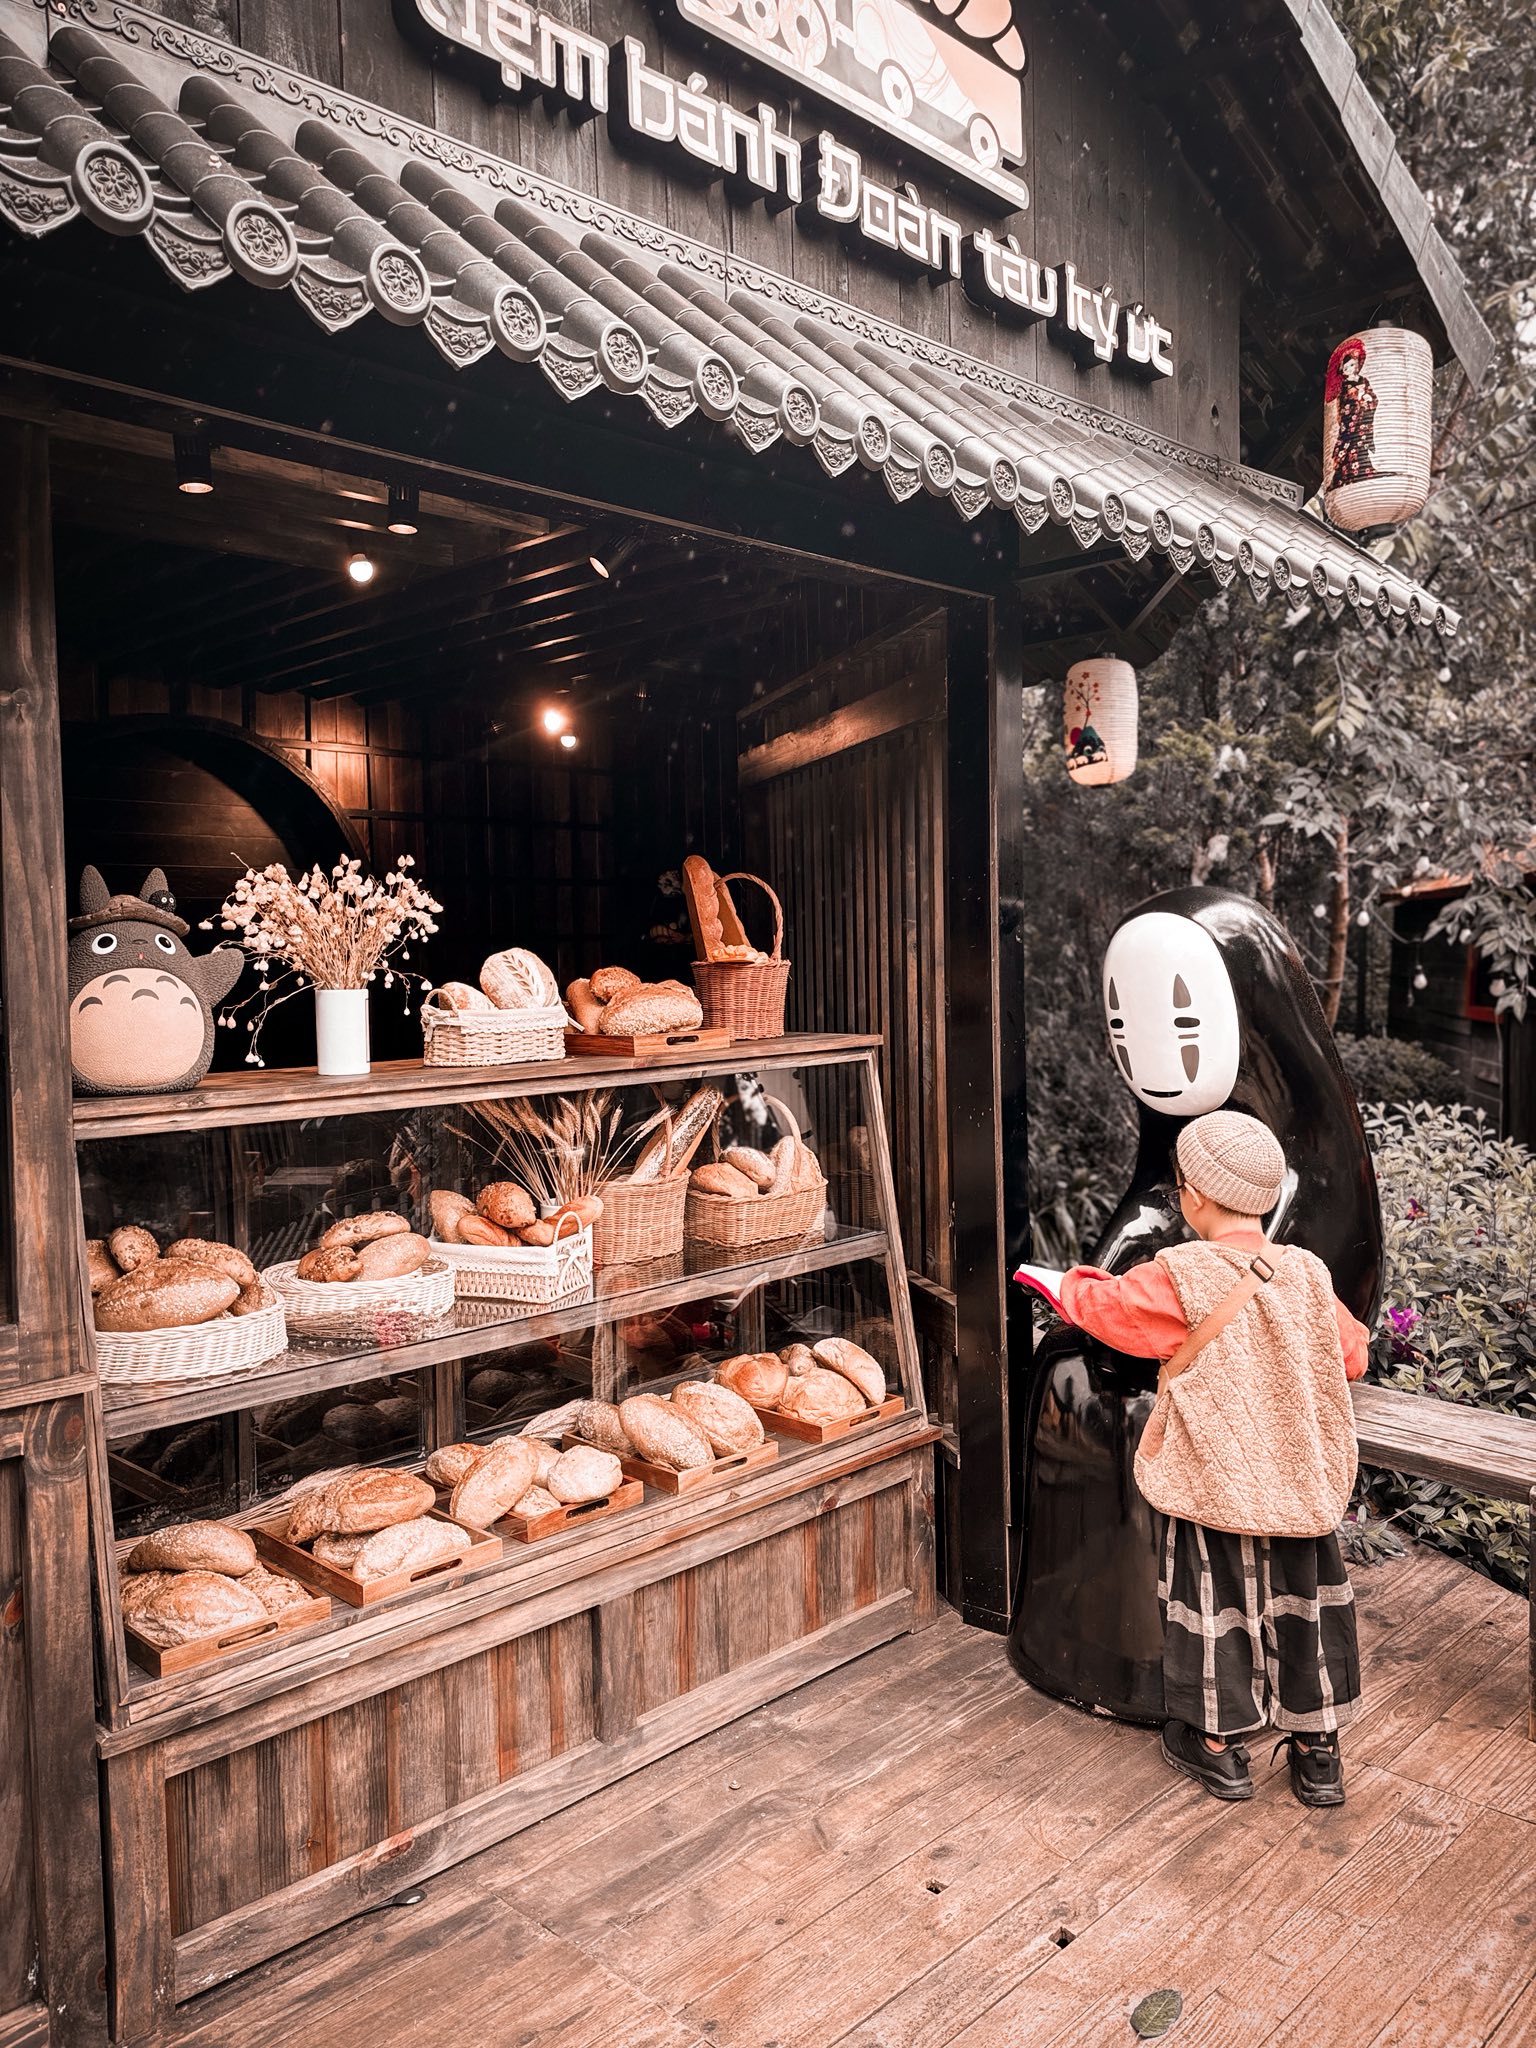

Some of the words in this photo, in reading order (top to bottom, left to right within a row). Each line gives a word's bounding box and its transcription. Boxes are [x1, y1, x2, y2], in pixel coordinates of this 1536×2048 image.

[625, 36, 801, 202] bánh
[819, 133, 960, 277] Đoàn
[975, 230, 1057, 316] tàu
[1066, 262, 1118, 361] ký
